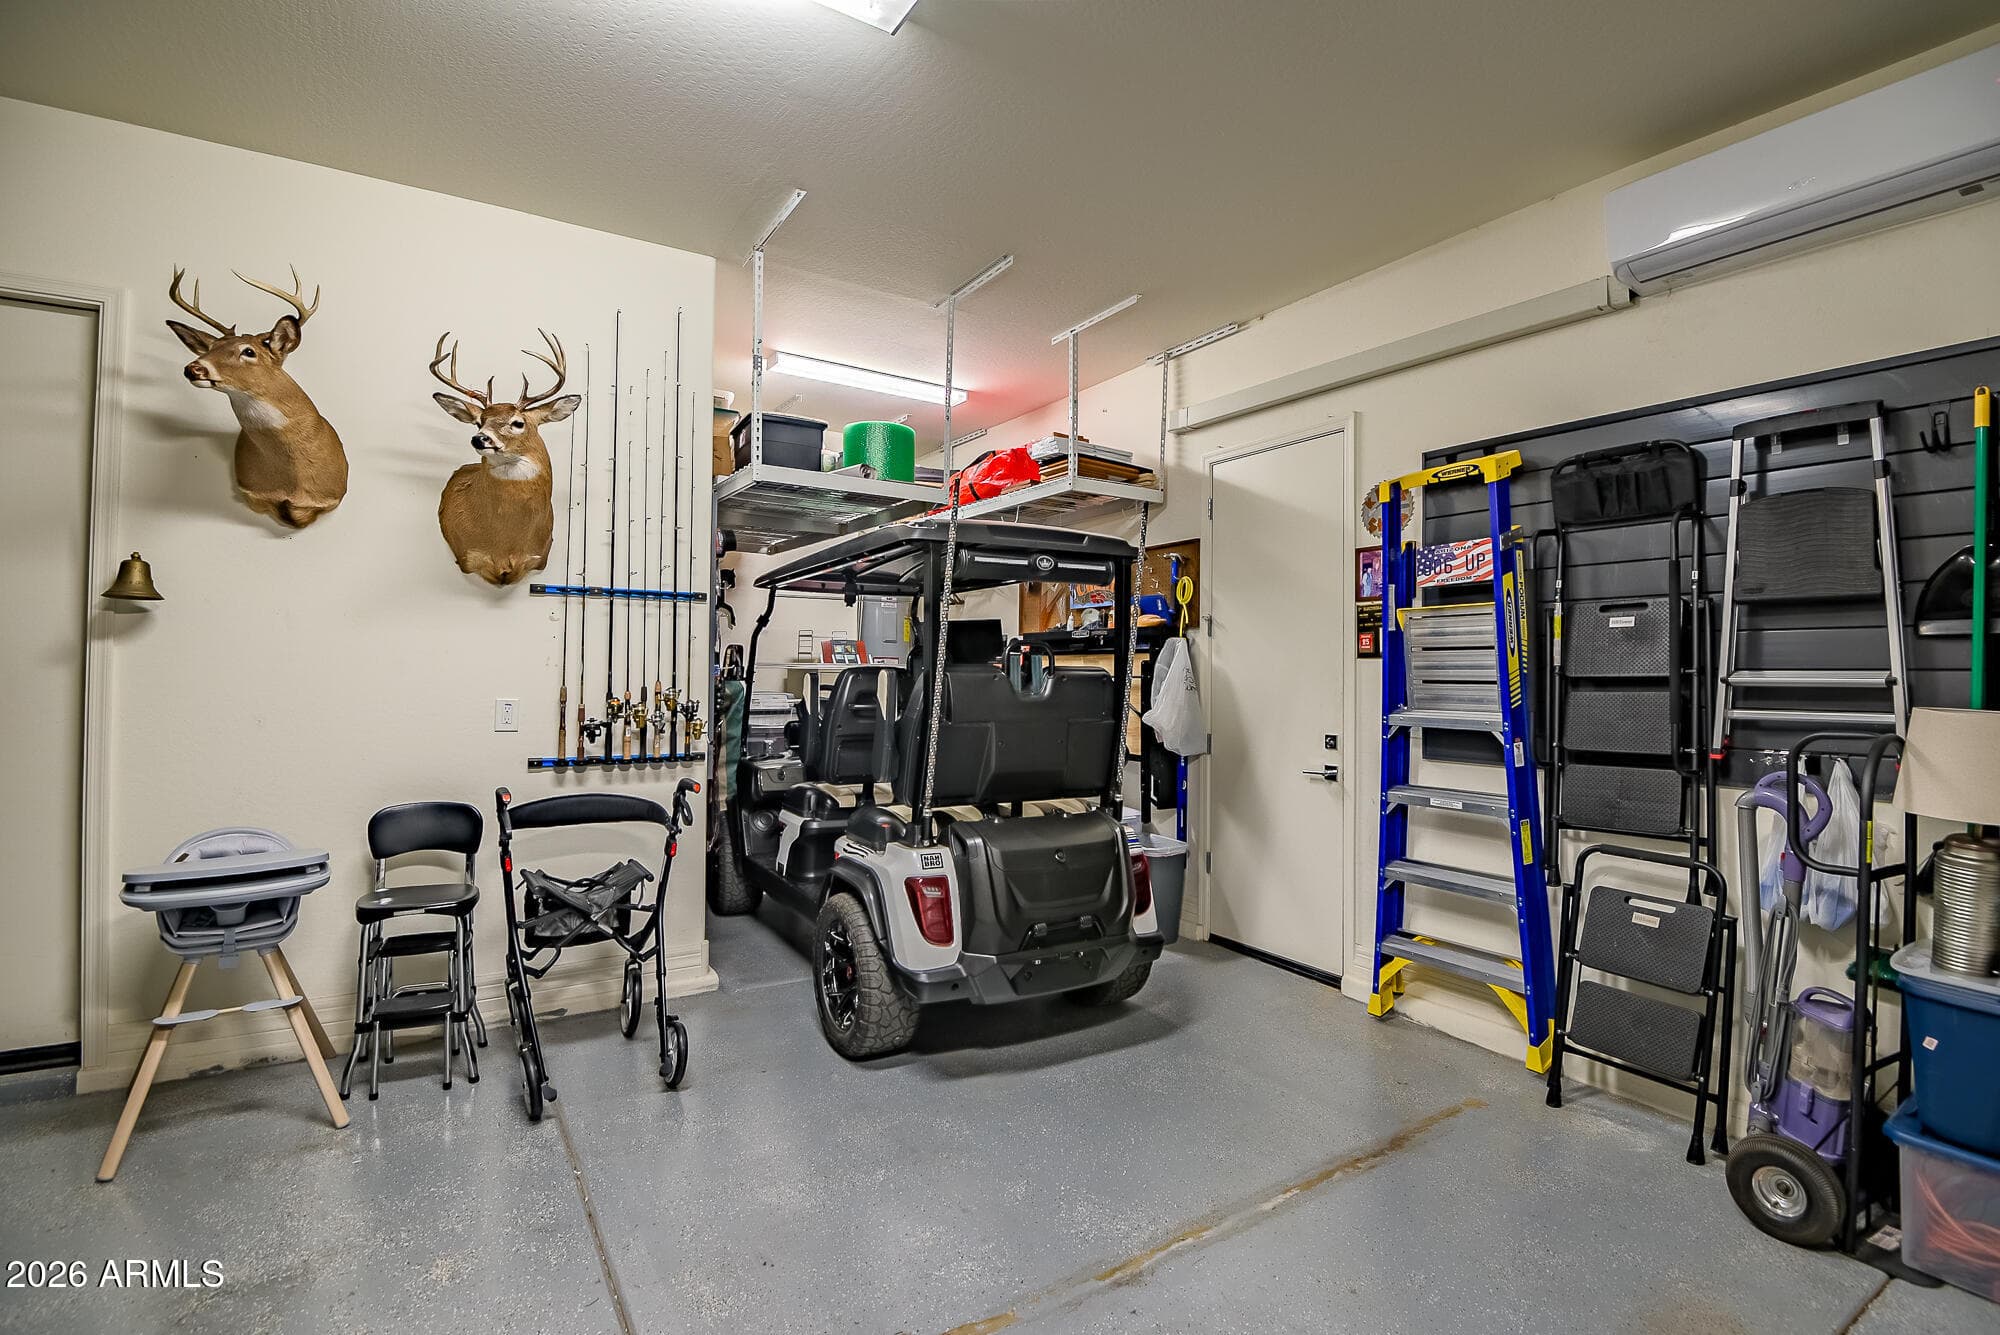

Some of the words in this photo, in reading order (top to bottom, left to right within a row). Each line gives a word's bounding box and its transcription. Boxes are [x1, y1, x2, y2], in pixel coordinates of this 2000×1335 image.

[1441, 466, 1471, 476] WERNER
[1435, 545, 1472, 555] ARIZONA
[1465, 553, 1485, 571] UP
[1436, 575, 1472, 584] FREEDOM
[1518, 581, 1526, 620] PODIUM
